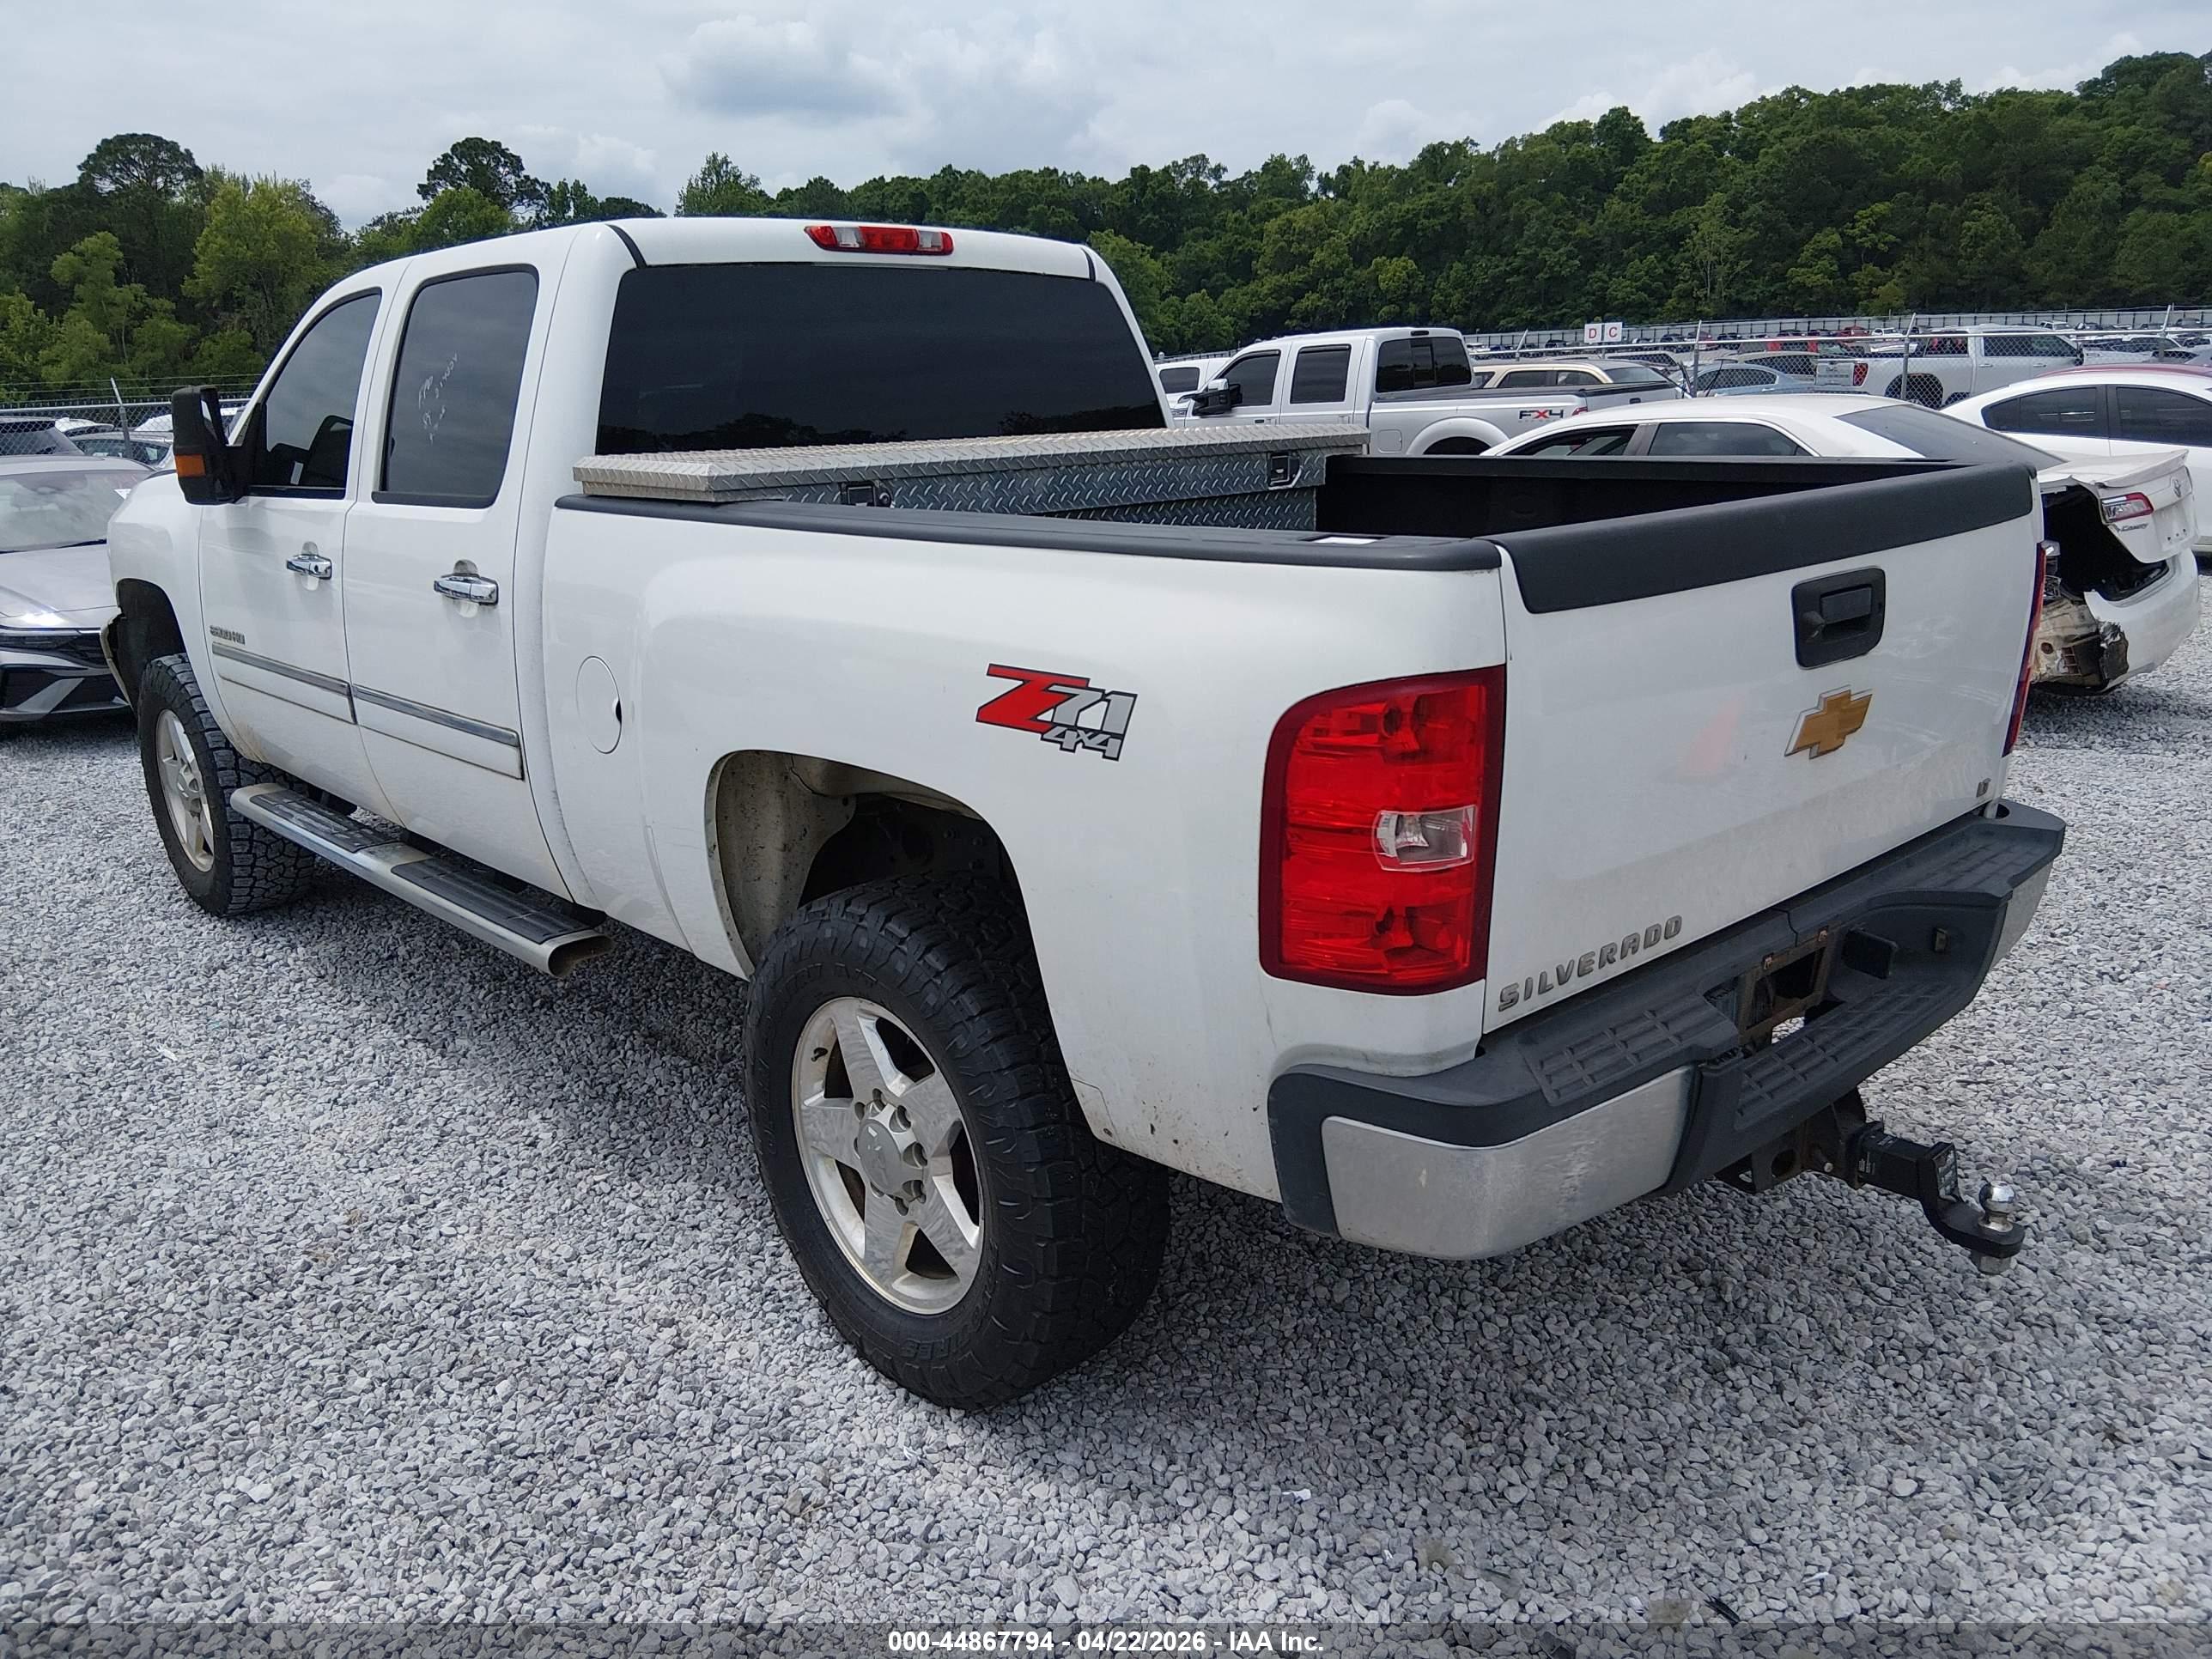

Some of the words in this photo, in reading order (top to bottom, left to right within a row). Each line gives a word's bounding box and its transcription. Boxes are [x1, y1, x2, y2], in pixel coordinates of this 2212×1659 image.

[1589, 328, 1597, 339] D
[1608, 326, 1618, 337] C
[1518, 409, 1564, 420] FX4
[975, 663, 1138, 737] Z71
[1498, 915, 1682, 1012] SILVERADO
